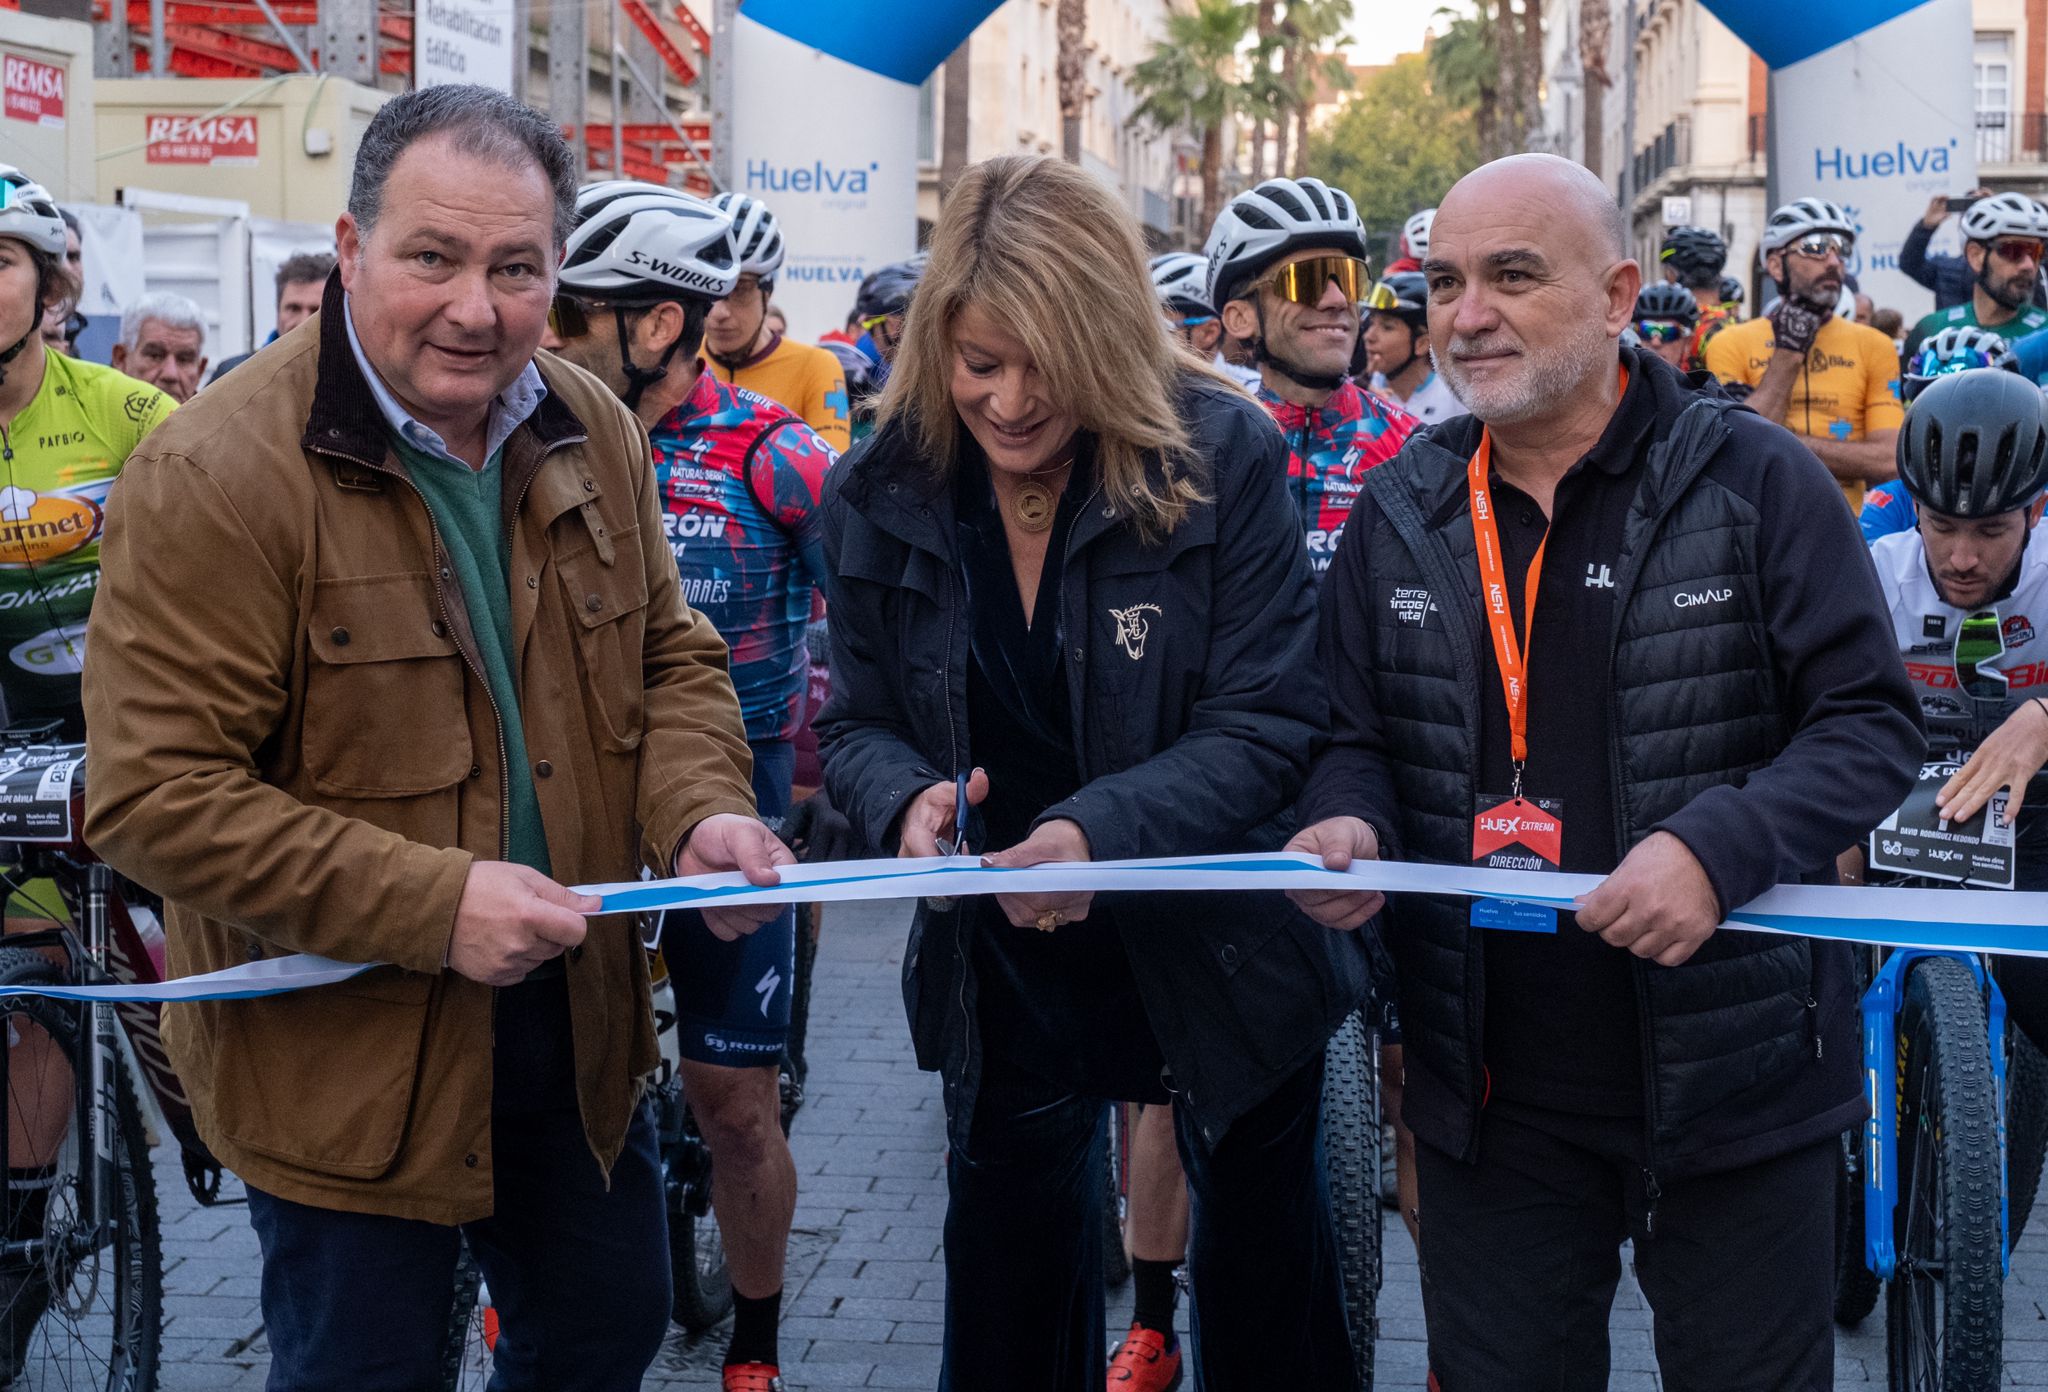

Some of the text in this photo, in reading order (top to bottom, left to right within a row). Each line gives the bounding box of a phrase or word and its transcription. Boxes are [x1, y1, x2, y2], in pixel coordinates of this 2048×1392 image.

[426, 37, 465, 71] Edificio
[5, 58, 64, 99] REMSA
[149, 117, 256, 144] REMSA
[1815, 141, 1949, 180] Huelva
[747, 160, 868, 192] Huelva
[625, 250, 728, 293] S-WORKS
[786, 267, 864, 282] HUELVA
[1829, 355, 1855, 368] Bike
[738, 388, 774, 410] GOBIK
[671, 466, 703, 480] NATURAL
[680, 577, 731, 603] ORRES
[1395, 587, 1428, 599] terra
[1489, 582, 1505, 614] HSN
[1481, 817, 1555, 835] HUEX EXTREMA
[1900, 827, 1918, 836] DAVID
[1920, 829, 1952, 842] RODRÍGUEZ
[1953, 834, 1980, 845] REDONDO
[1489, 855, 1543, 871] DIRECCIÓN
